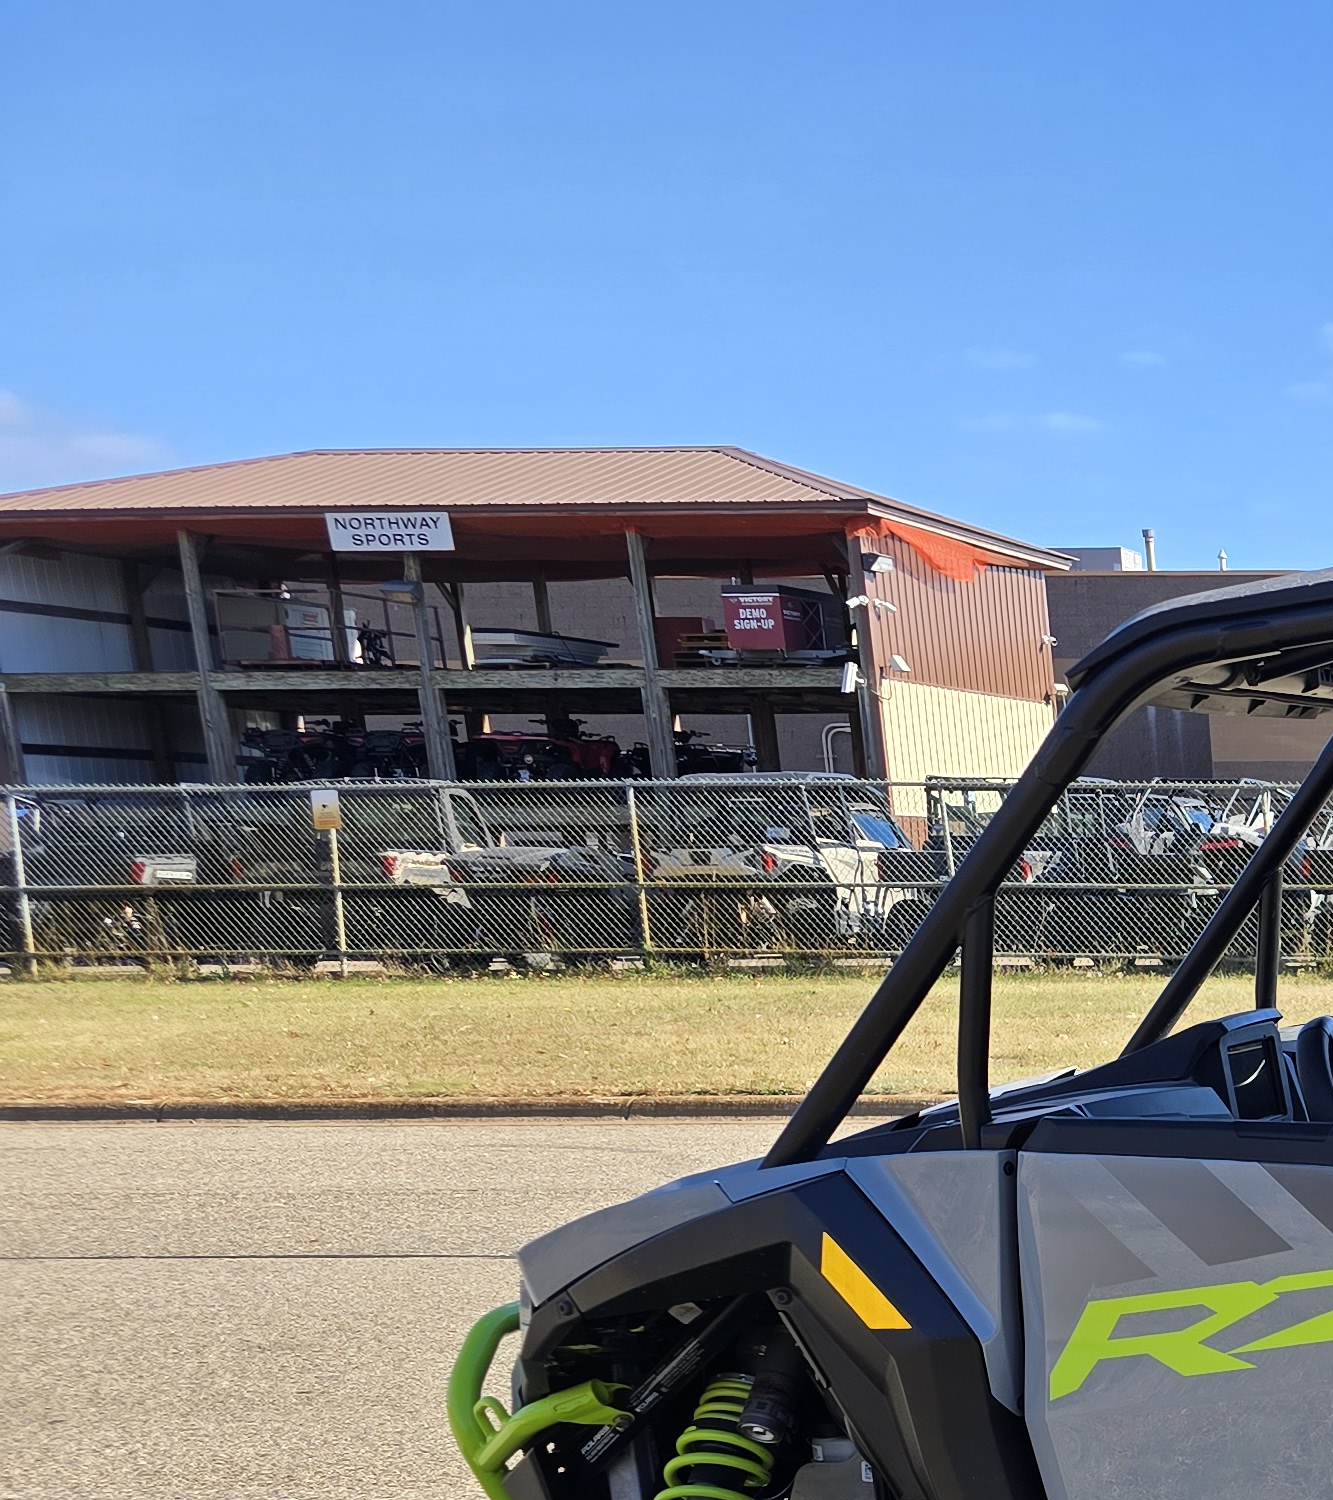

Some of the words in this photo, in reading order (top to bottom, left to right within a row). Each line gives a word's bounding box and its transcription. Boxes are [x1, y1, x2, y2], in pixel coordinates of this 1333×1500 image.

[333, 517, 441, 530] NORTHWAY
[351, 533, 429, 546] SPORTS
[738, 608, 767, 619] DEMO
[733, 619, 775, 630] SIGN-UP
